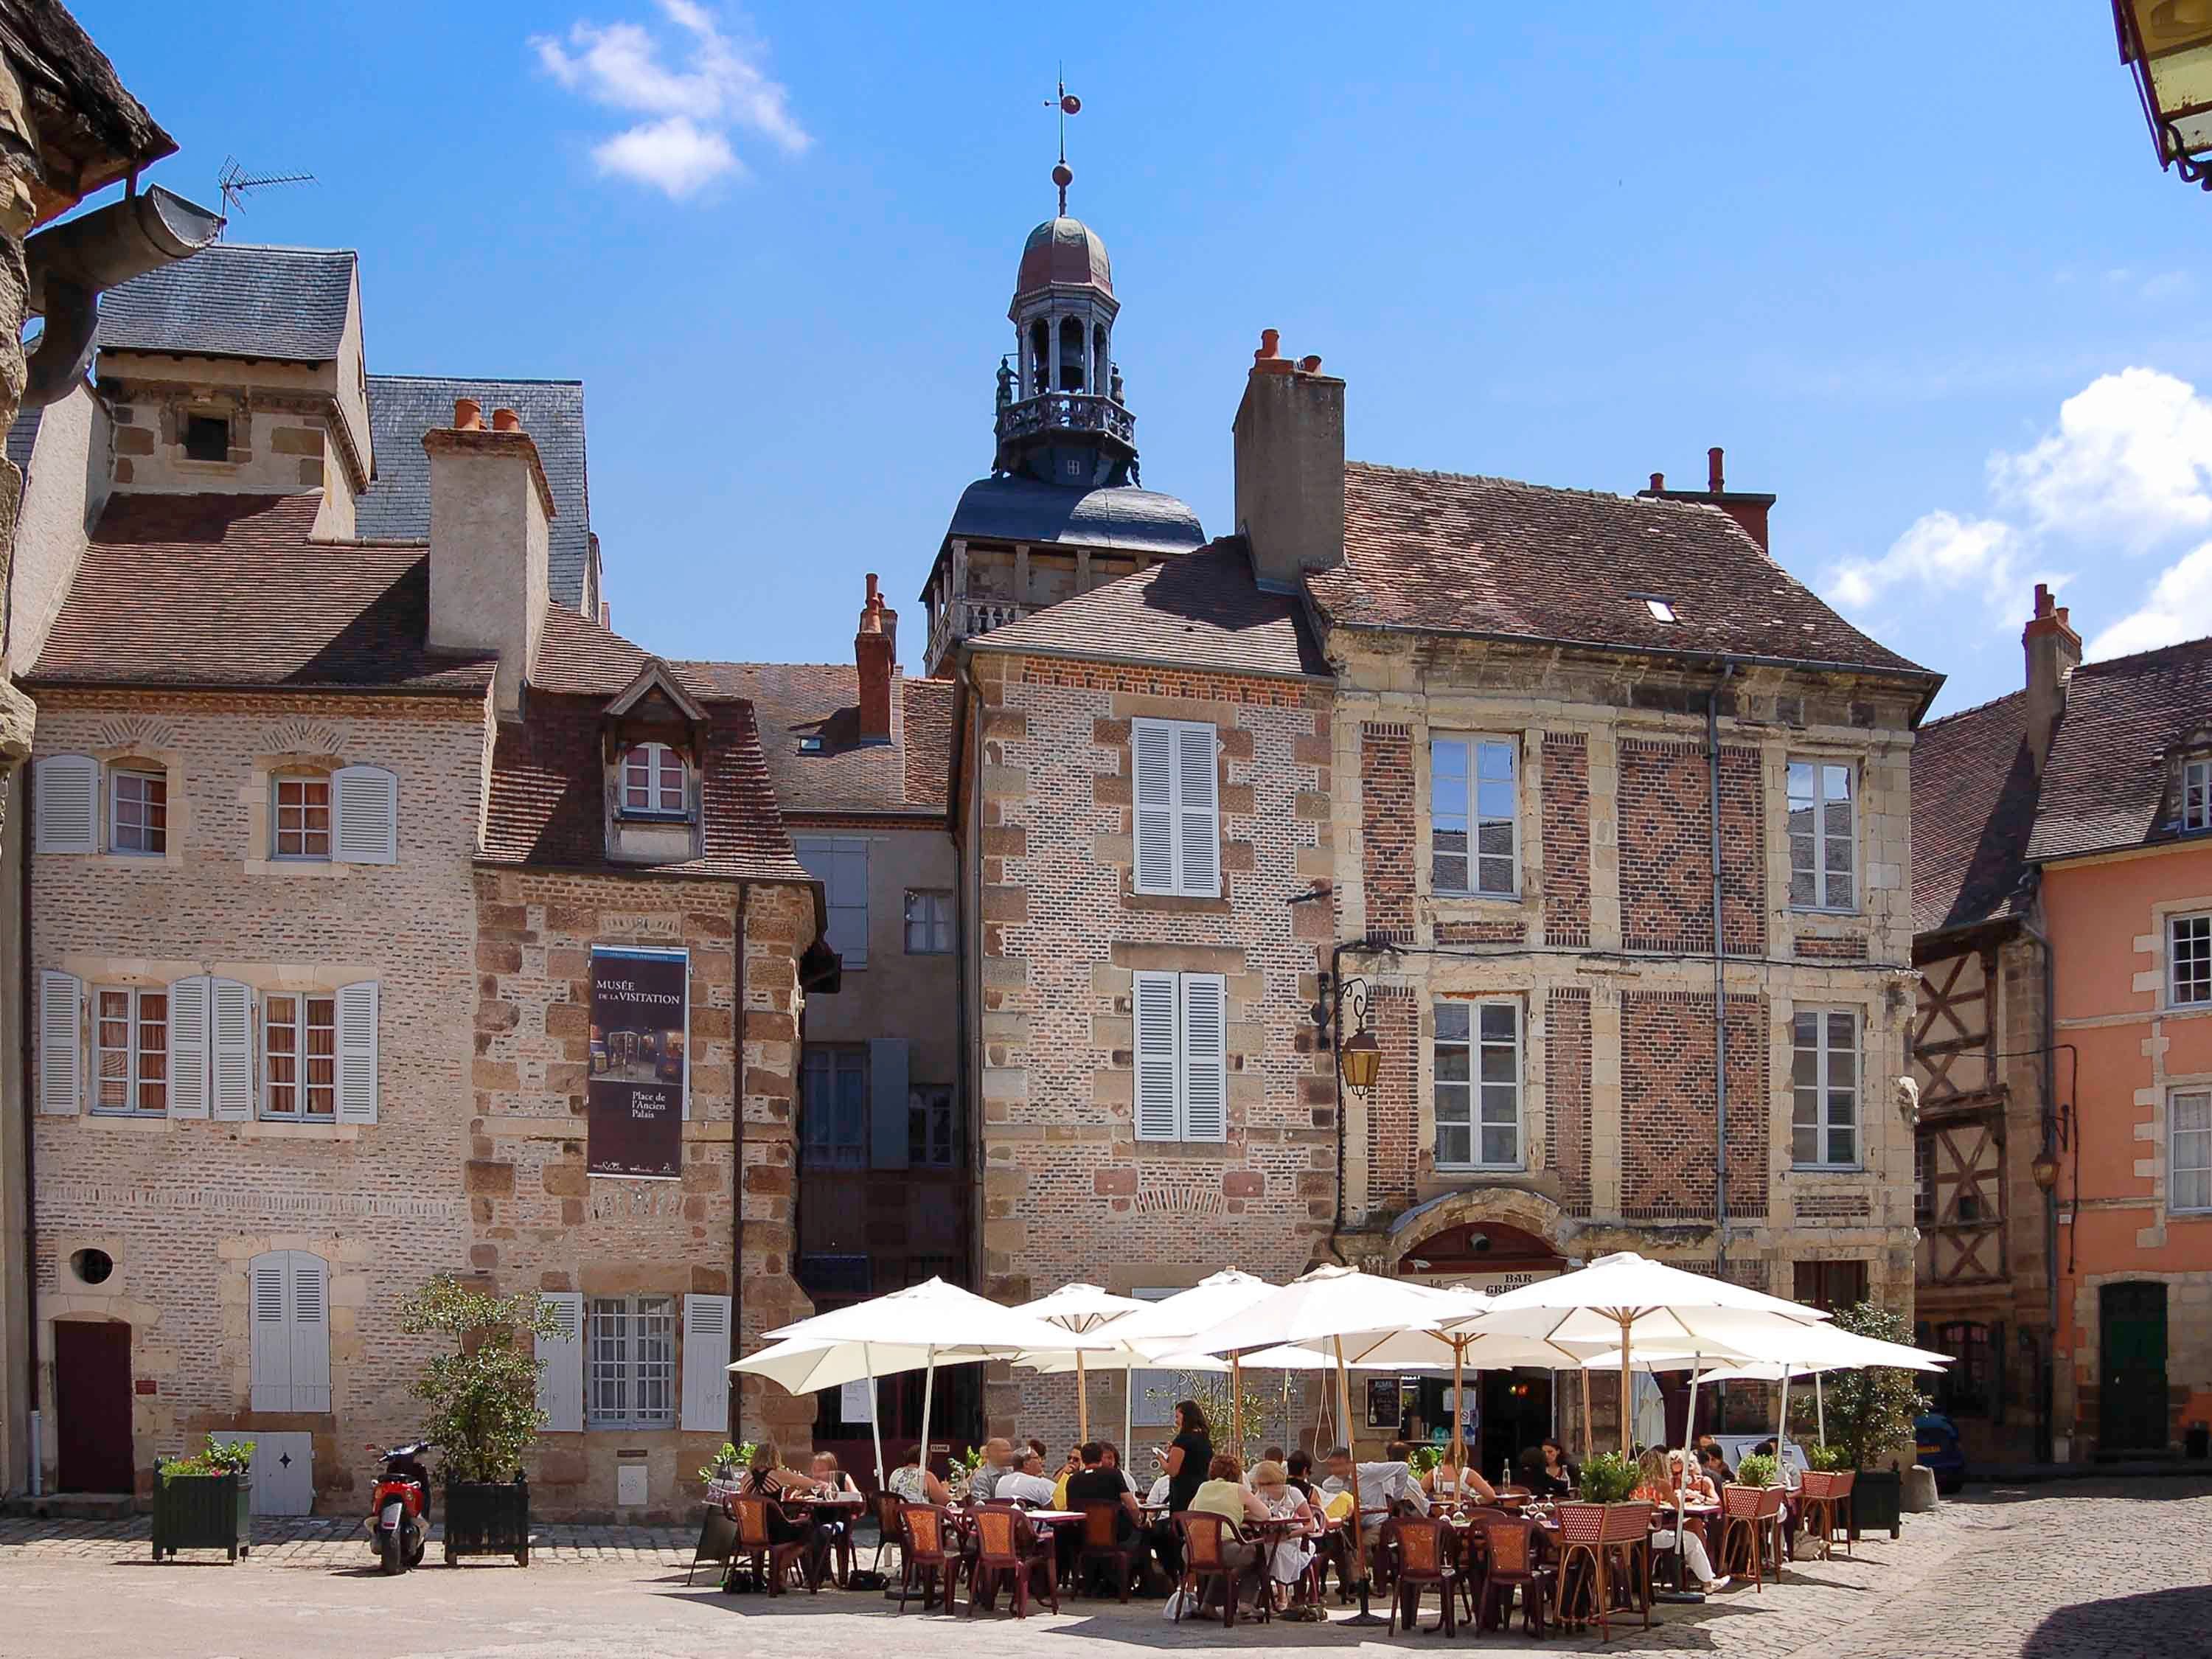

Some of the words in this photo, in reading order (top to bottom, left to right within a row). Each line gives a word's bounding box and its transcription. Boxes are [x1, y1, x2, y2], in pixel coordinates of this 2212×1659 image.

[596, 979, 635, 991] MUSÉE
[619, 991, 680, 1005] VISITATION
[632, 1091, 654, 1101] Place
[655, 1092, 666, 1102] de
[632, 1099, 666, 1110] l'Ancien
[632, 1109, 655, 1119] Palais
[1505, 1273, 1532, 1283] BAR
